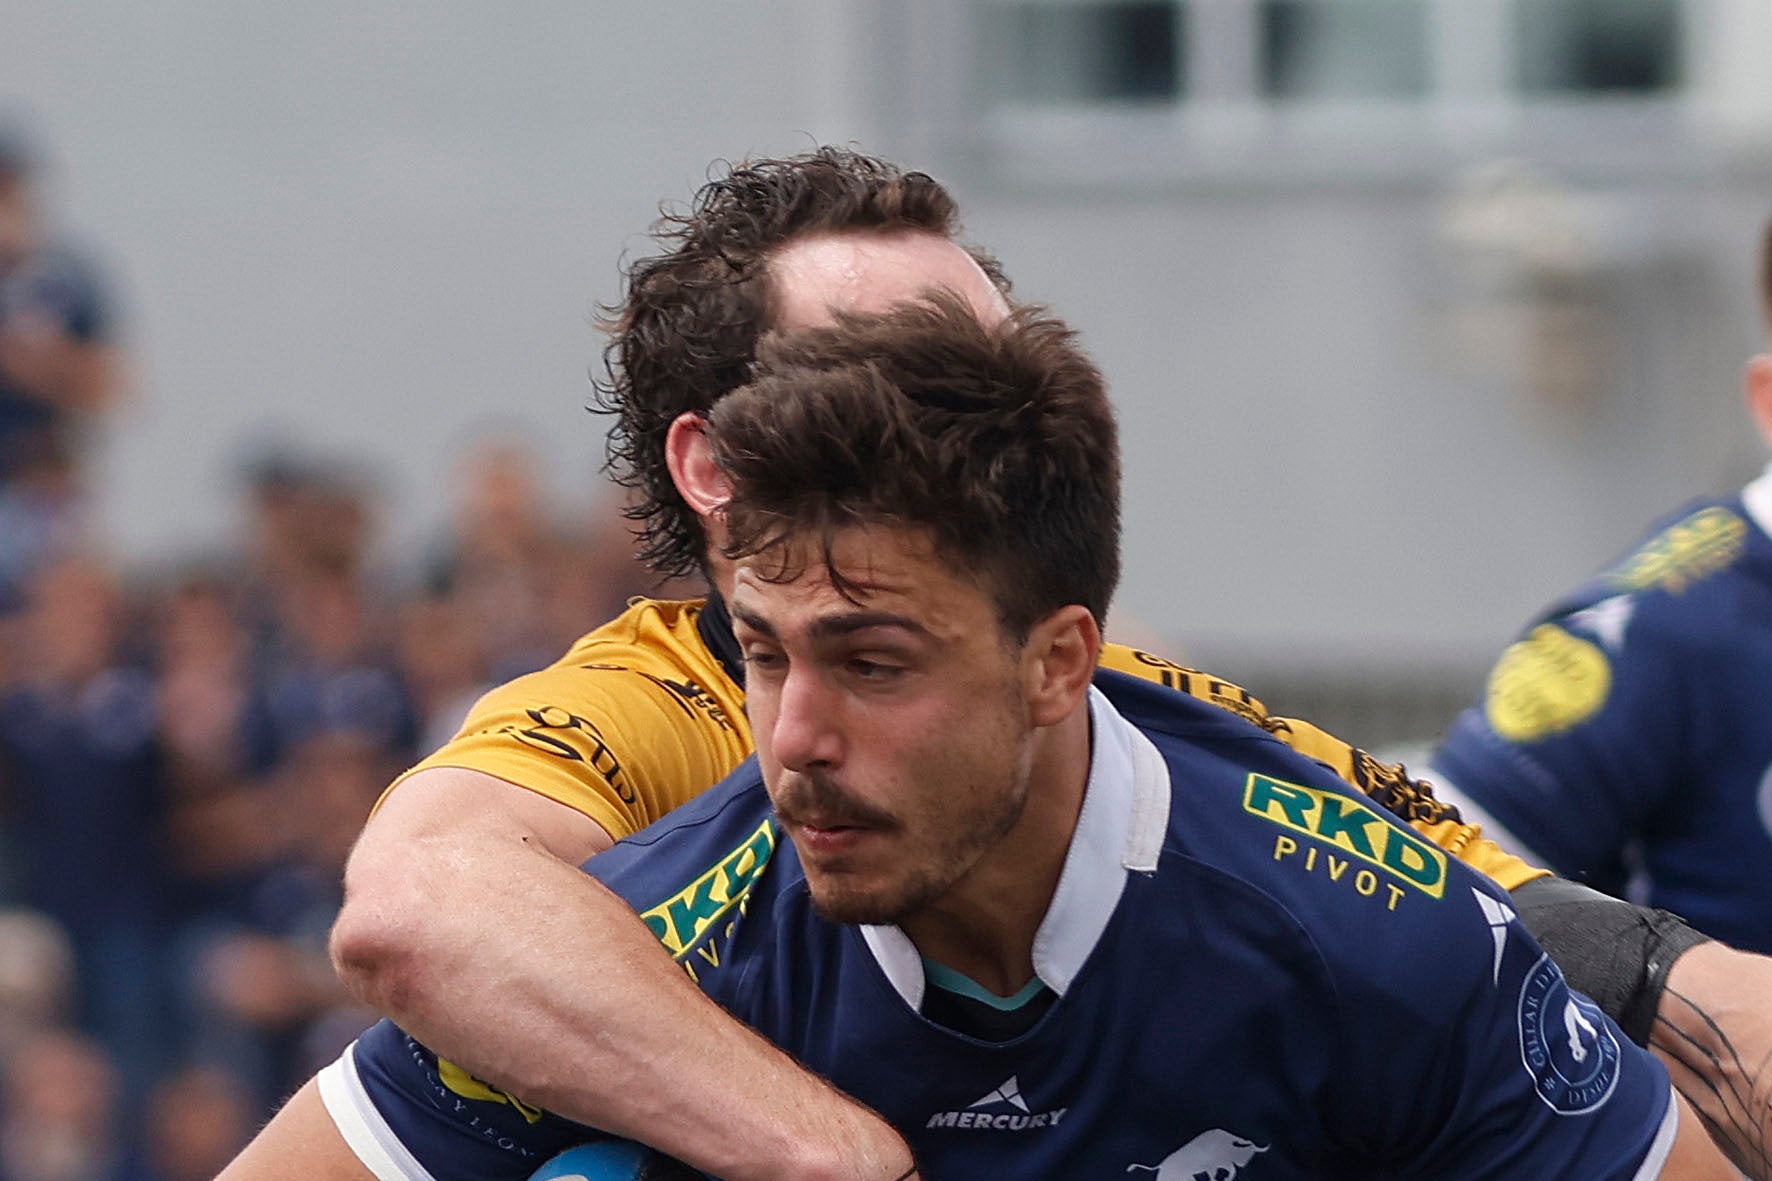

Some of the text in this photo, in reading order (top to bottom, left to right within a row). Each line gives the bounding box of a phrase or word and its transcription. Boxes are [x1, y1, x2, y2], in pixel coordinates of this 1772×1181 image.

[1250, 776, 1441, 886] RKD
[1272, 835, 1406, 912] PIVOT
[926, 1107, 1068, 1131] MERCURY
